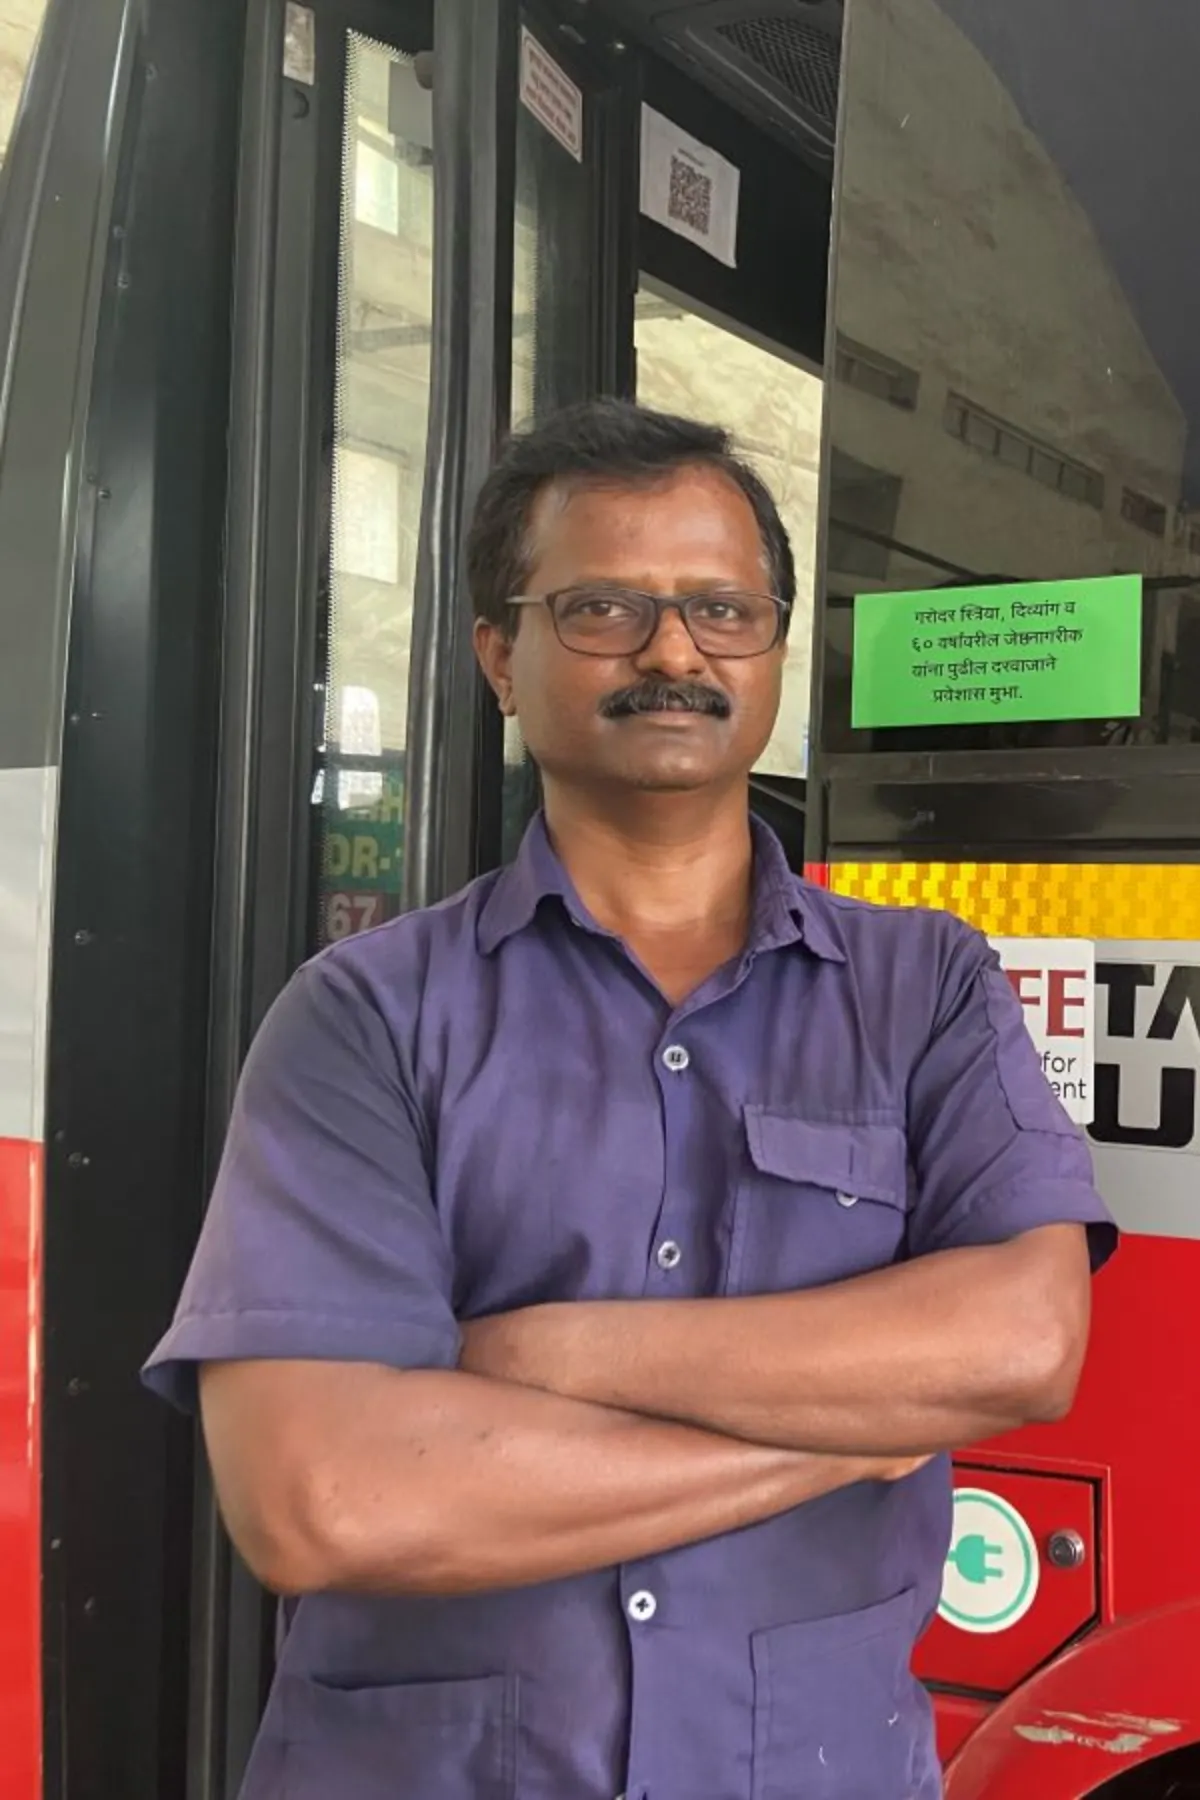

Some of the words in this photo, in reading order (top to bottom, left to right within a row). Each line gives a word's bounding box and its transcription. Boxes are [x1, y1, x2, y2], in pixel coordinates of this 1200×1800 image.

[915, 607, 955, 624] गरोदर
[1011, 600, 1059, 619] दिव्यांग
[1065, 601, 1076, 615] व
[911, 637, 933, 652] ६०
[911, 661, 943, 678] यांना
[948, 657, 987, 680] पुढील
[933, 685, 985, 703] प्रवेशास
[989, 685, 1023, 704] मुभा.
[1004, 968, 1087, 1037] FE
[1043, 1051, 1077, 1073] for
[1051, 1078, 1087, 1099] ent
